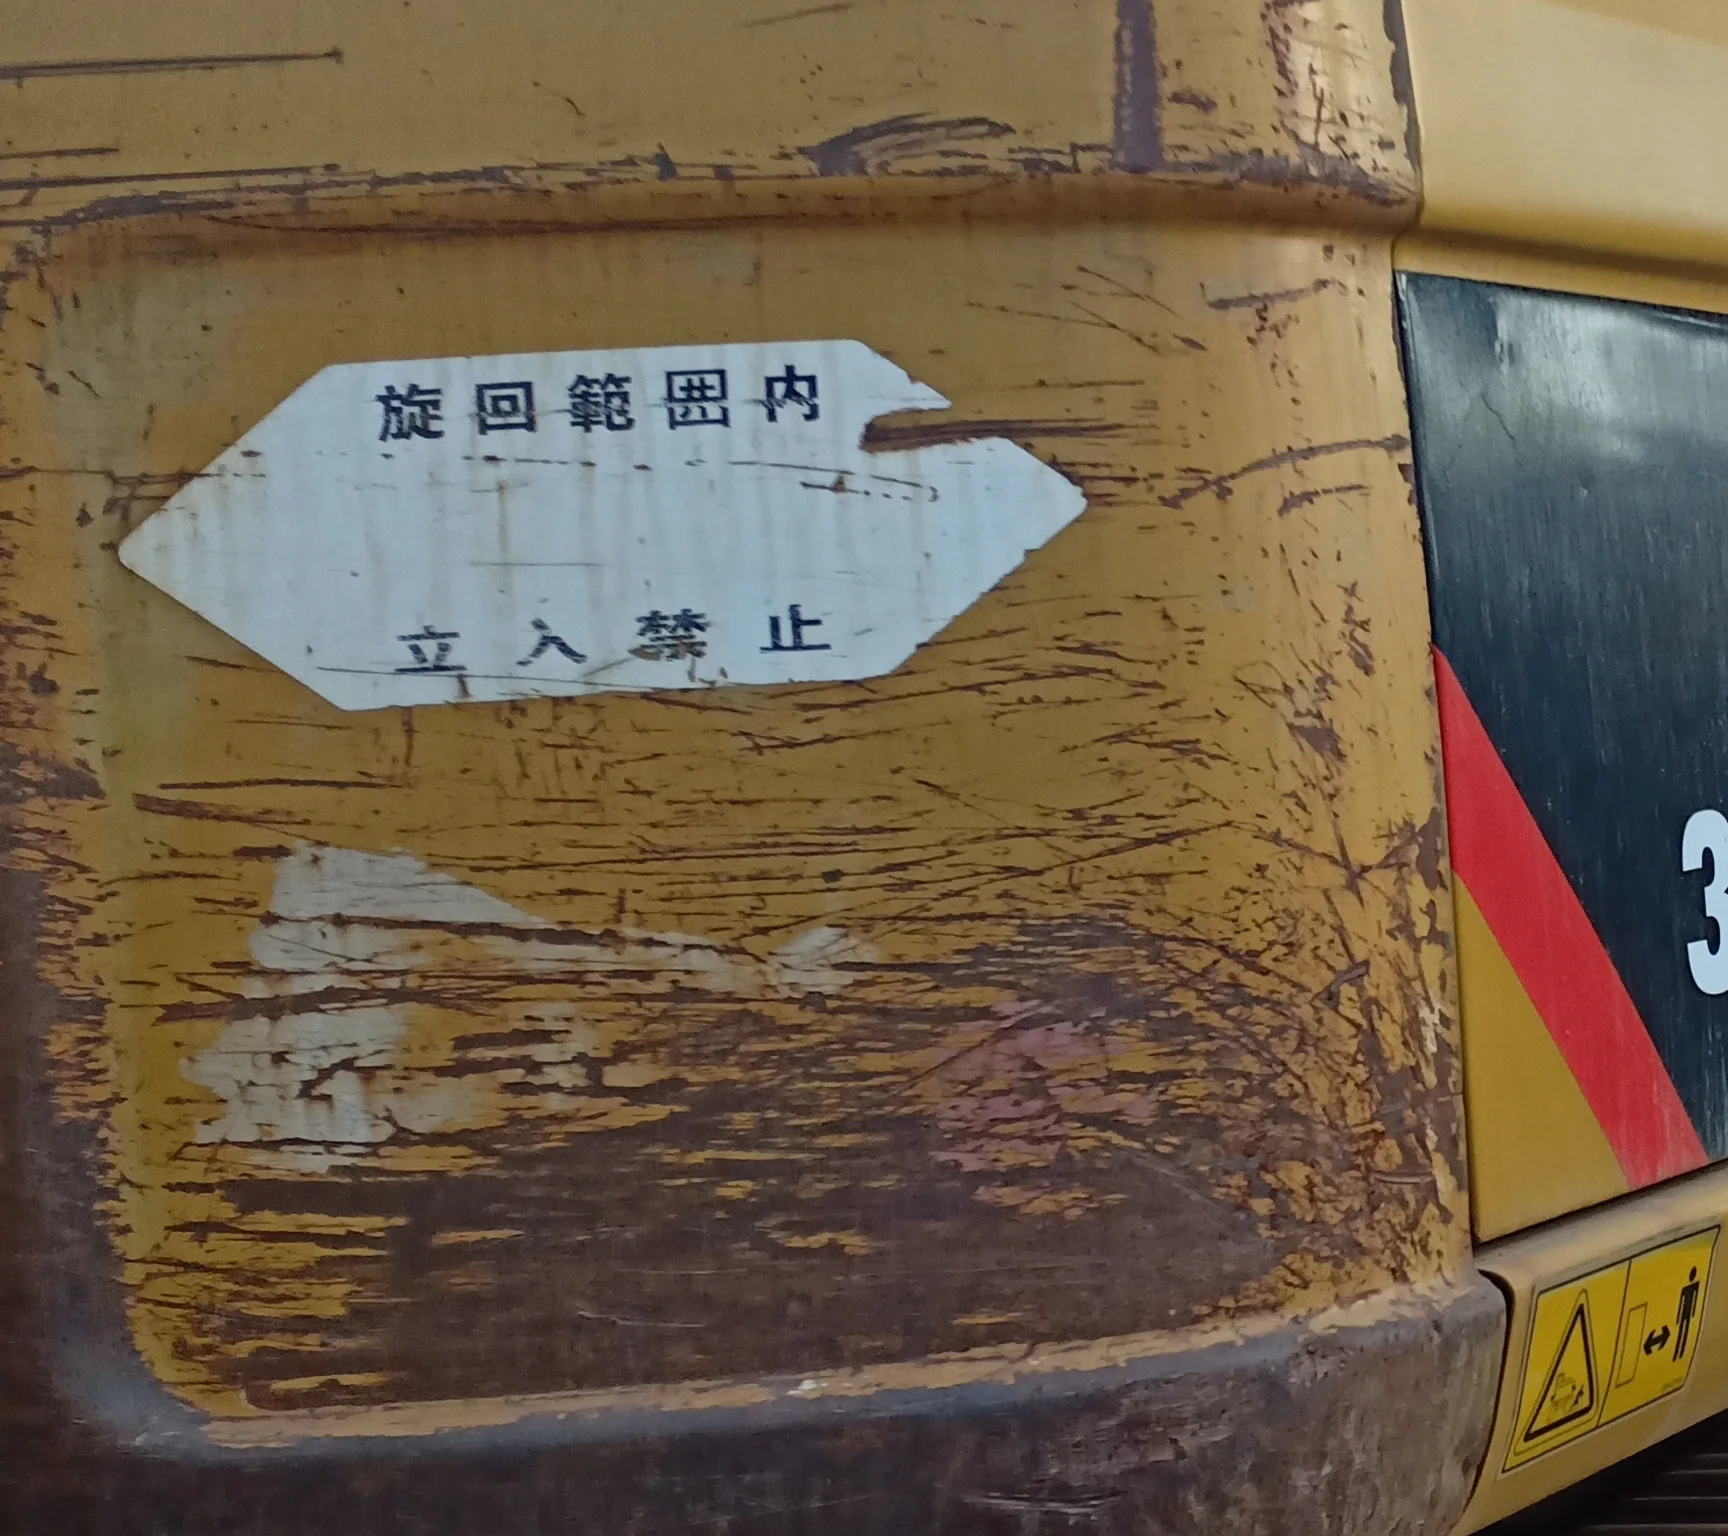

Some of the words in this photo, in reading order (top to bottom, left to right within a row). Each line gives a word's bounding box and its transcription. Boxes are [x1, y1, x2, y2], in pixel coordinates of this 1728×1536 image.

[376, 365, 821, 442] 旋回範囲内
[395, 603, 832, 673] 立入禁止
